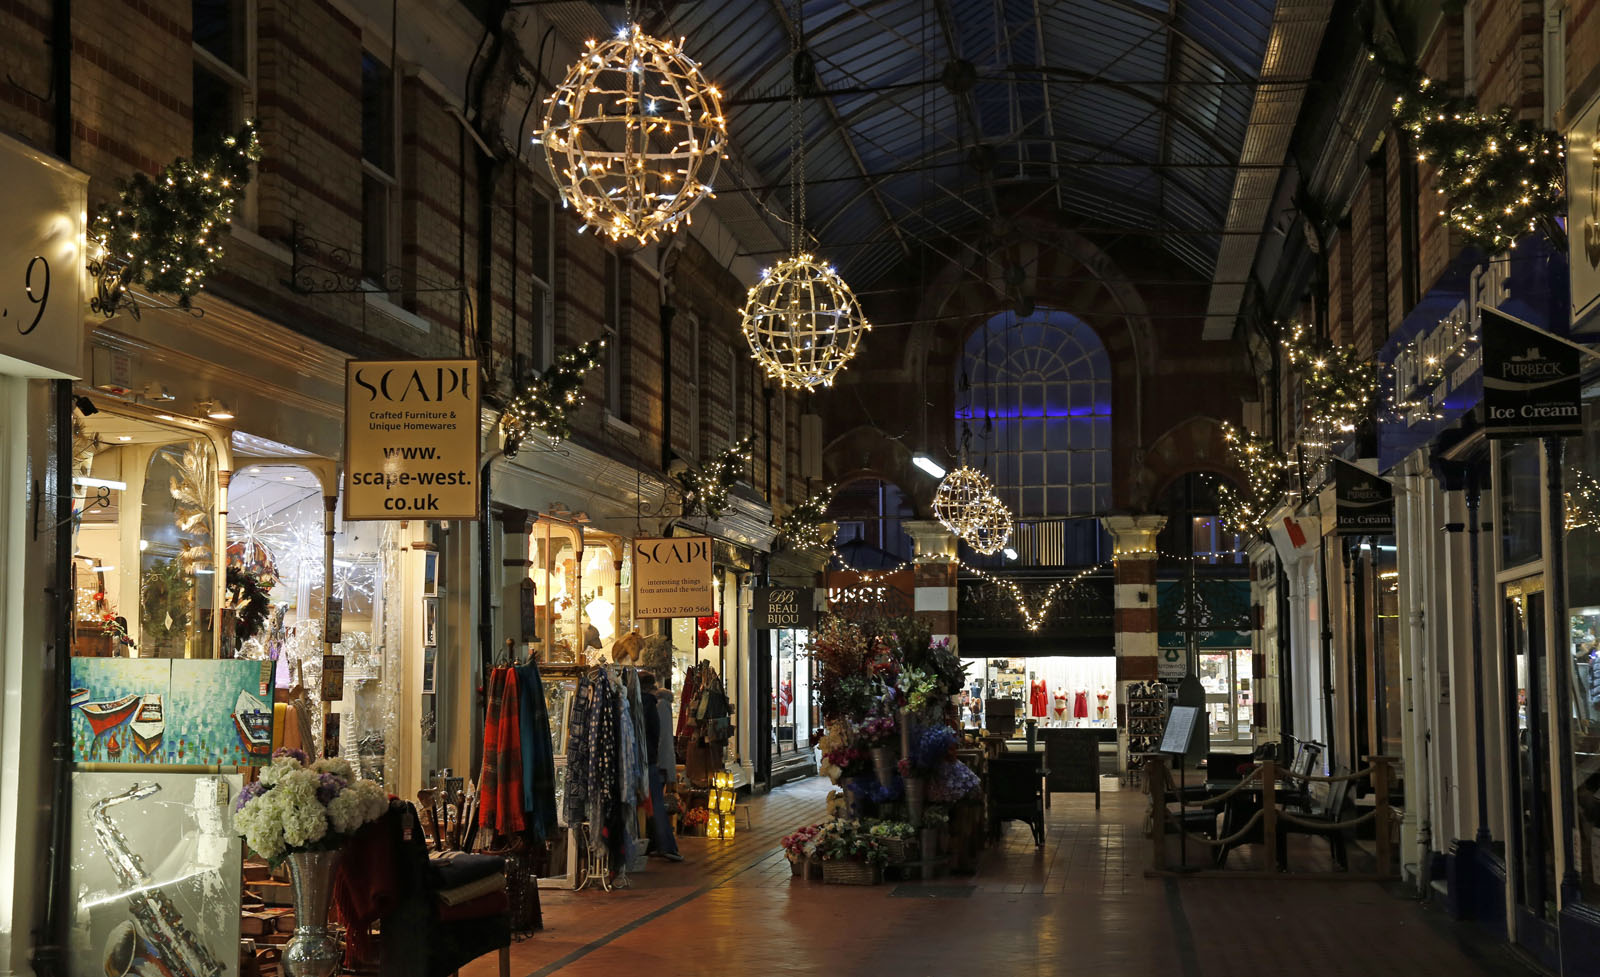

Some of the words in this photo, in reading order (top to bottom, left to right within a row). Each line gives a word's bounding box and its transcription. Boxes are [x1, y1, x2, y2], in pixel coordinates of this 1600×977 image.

[1502, 362, 1566, 378] PURBECK
[369, 411, 403, 419] Crafted
[405, 411, 448, 419] Furniture
[449, 411, 456, 419] &
[1489, 406, 1515, 419] Ice
[1520, 404, 1578, 418] Cream
[369, 422, 401, 432] Unique
[403, 422, 457, 430] Homewares
[383, 447, 441, 460] www.
[352, 470, 472, 490] scape-west.
[383, 493, 439, 511] co.uk
[1340, 515, 1355, 524] Ice
[1357, 515, 1391, 524] Cream
[647, 578, 680, 586] interesting
[681, 577, 701, 585] things
[769, 604, 798, 613] BEAU
[768, 615, 799, 625] BIJOU
